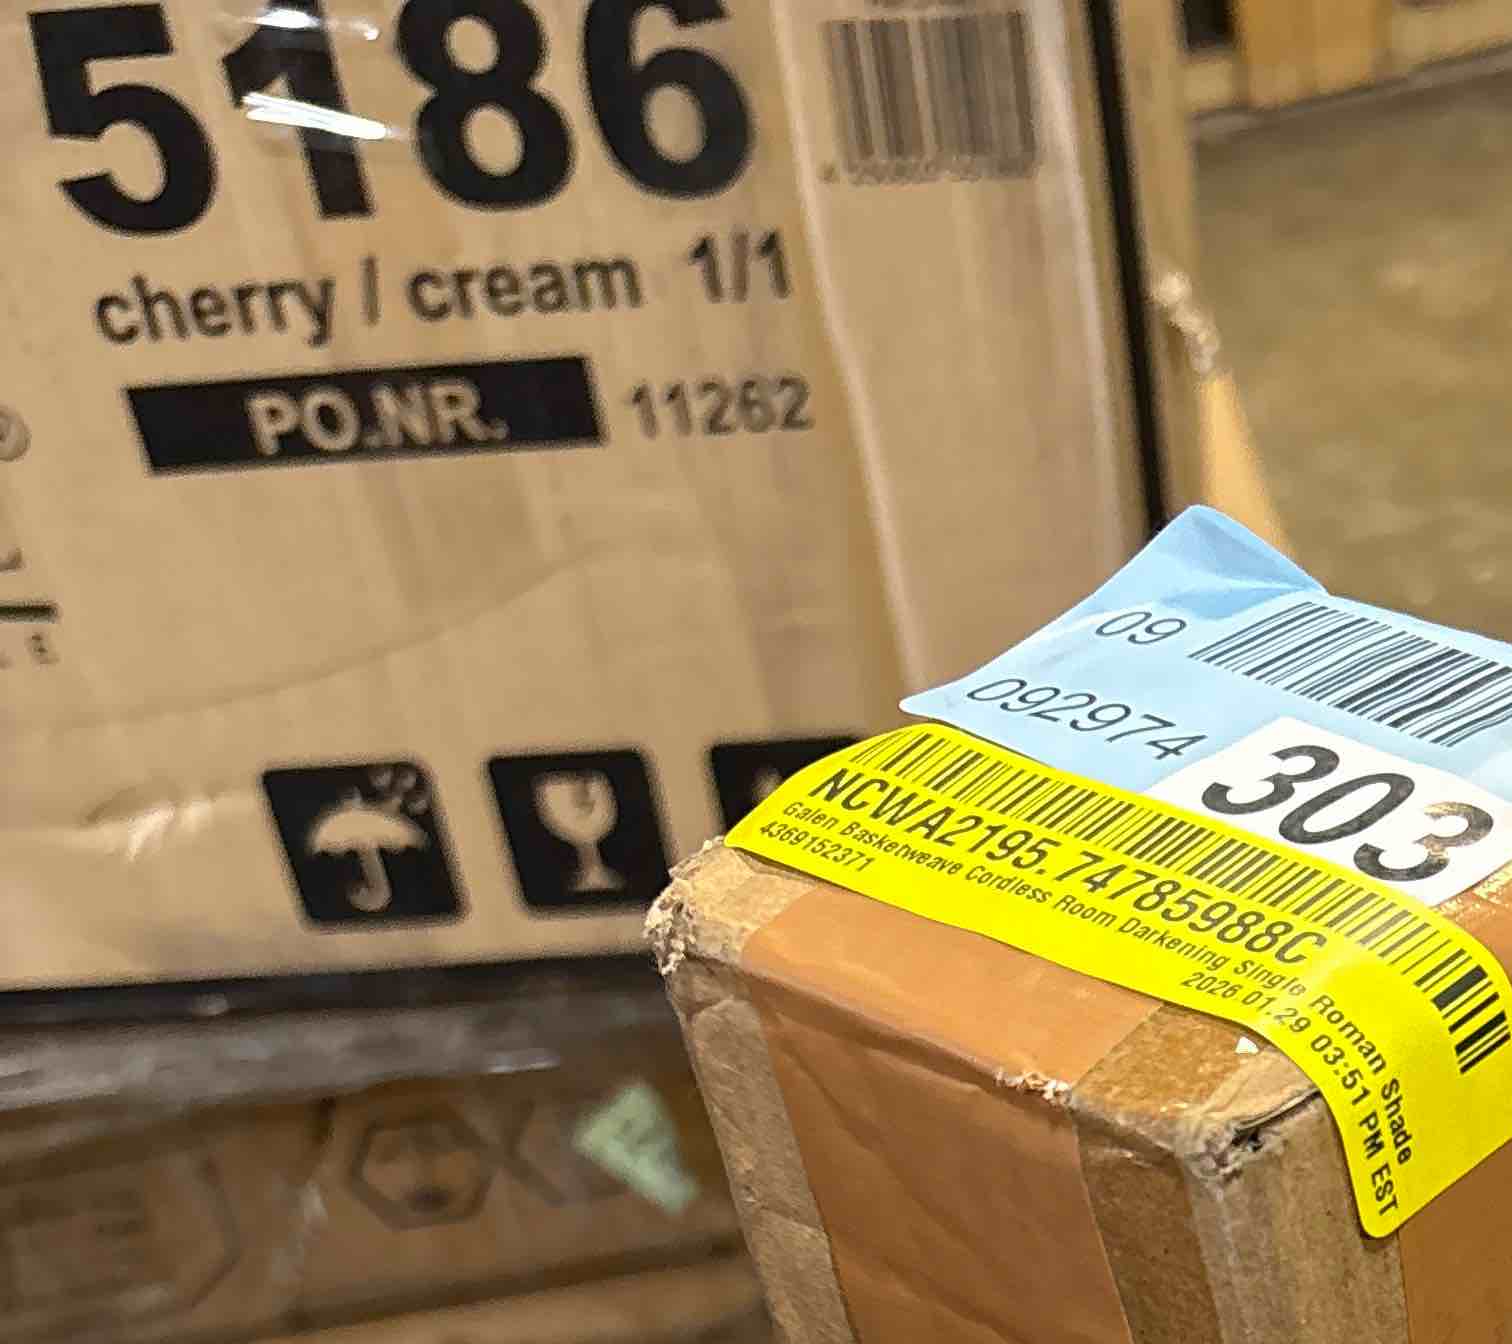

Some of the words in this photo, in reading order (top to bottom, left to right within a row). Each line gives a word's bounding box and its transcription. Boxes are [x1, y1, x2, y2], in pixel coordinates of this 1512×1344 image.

[27, 0, 756, 238] 5186
[95, 271, 337, 348] cherry
[406, 256, 646, 322] cream
[688, 227, 791, 303] 1/1
[247, 376, 509, 457] PO.NR.
[631, 374, 814, 440] 11262
[1095, 610, 1187, 646] 09
[966, 677, 1208, 761] 092974
[1200, 744, 1494, 882] 303
[808, 766, 1327, 964] NCWA2195.74785988C
[783, 801, 839, 830] Galen
[965, 865, 1053, 904] Cordless
[1053, 894, 1117, 928] Room
[1118, 916, 1231, 972] Darkening
[1233, 959, 1306, 997] Single
[1309, 993, 1387, 1076] Roman
[1380, 1077, 1413, 1166] Shade
[1310, 1033, 1372, 1107] 03:51
[1359, 1110, 1386, 1161] PM
[1371, 1162, 1399, 1217] EST
